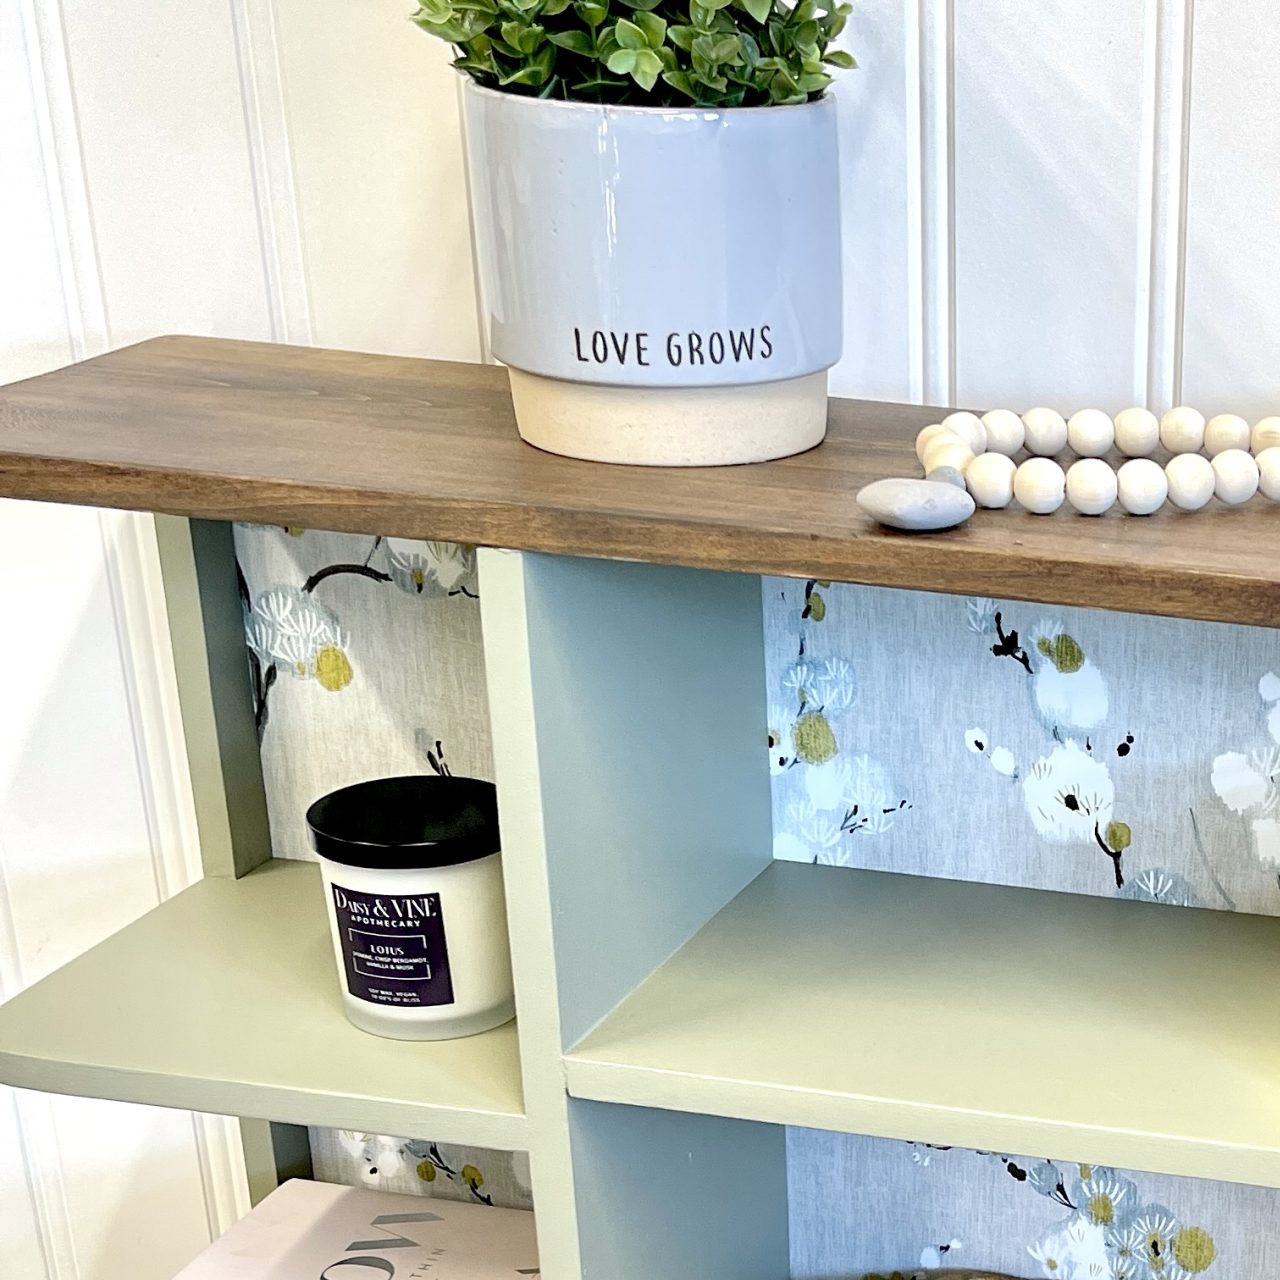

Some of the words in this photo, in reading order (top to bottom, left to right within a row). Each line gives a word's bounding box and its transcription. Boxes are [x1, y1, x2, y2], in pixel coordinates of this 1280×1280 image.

[573, 327, 650, 366] LOVE
[666, 325, 773, 367] GROWS
[373, 899, 390, 918] &
[391, 897, 437, 918] VINE
[351, 915, 421, 928] APOTHECARY
[370, 944, 405, 956] LOTUS
